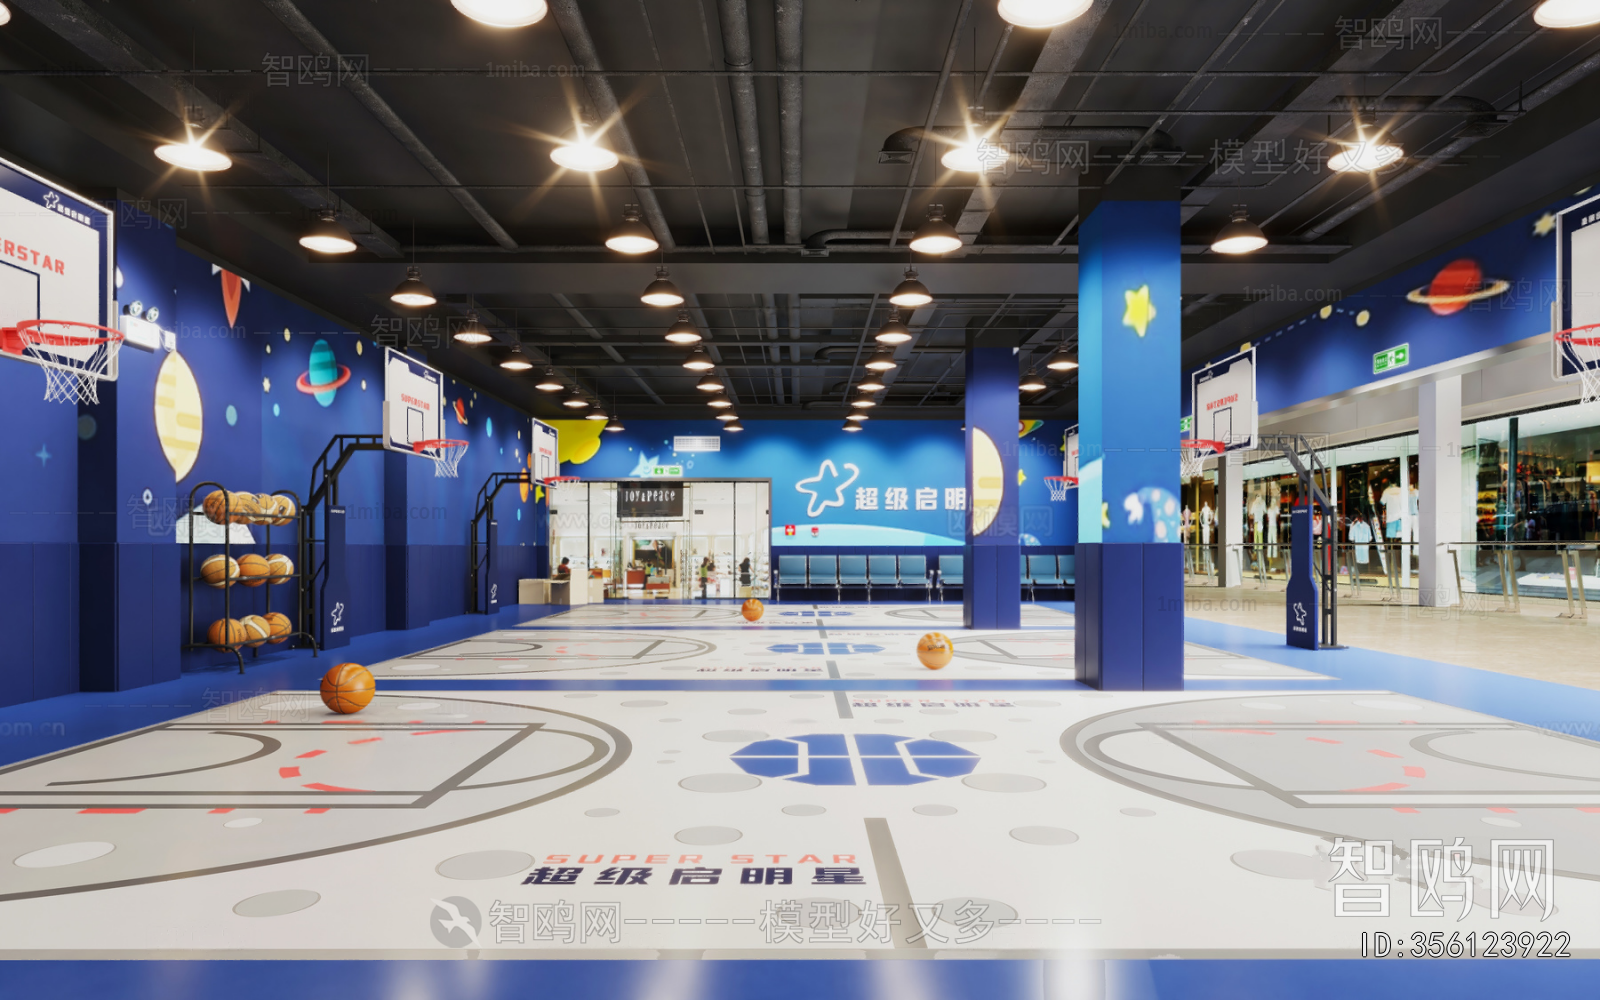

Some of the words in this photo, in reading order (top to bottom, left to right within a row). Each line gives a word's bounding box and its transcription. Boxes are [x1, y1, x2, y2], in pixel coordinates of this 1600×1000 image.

[0, 237, 64, 276] RSTAR
[542, 853, 704, 865] SUPER
[730, 853, 858, 865] STAR
[520, 866, 867, 887] 超级启明星
